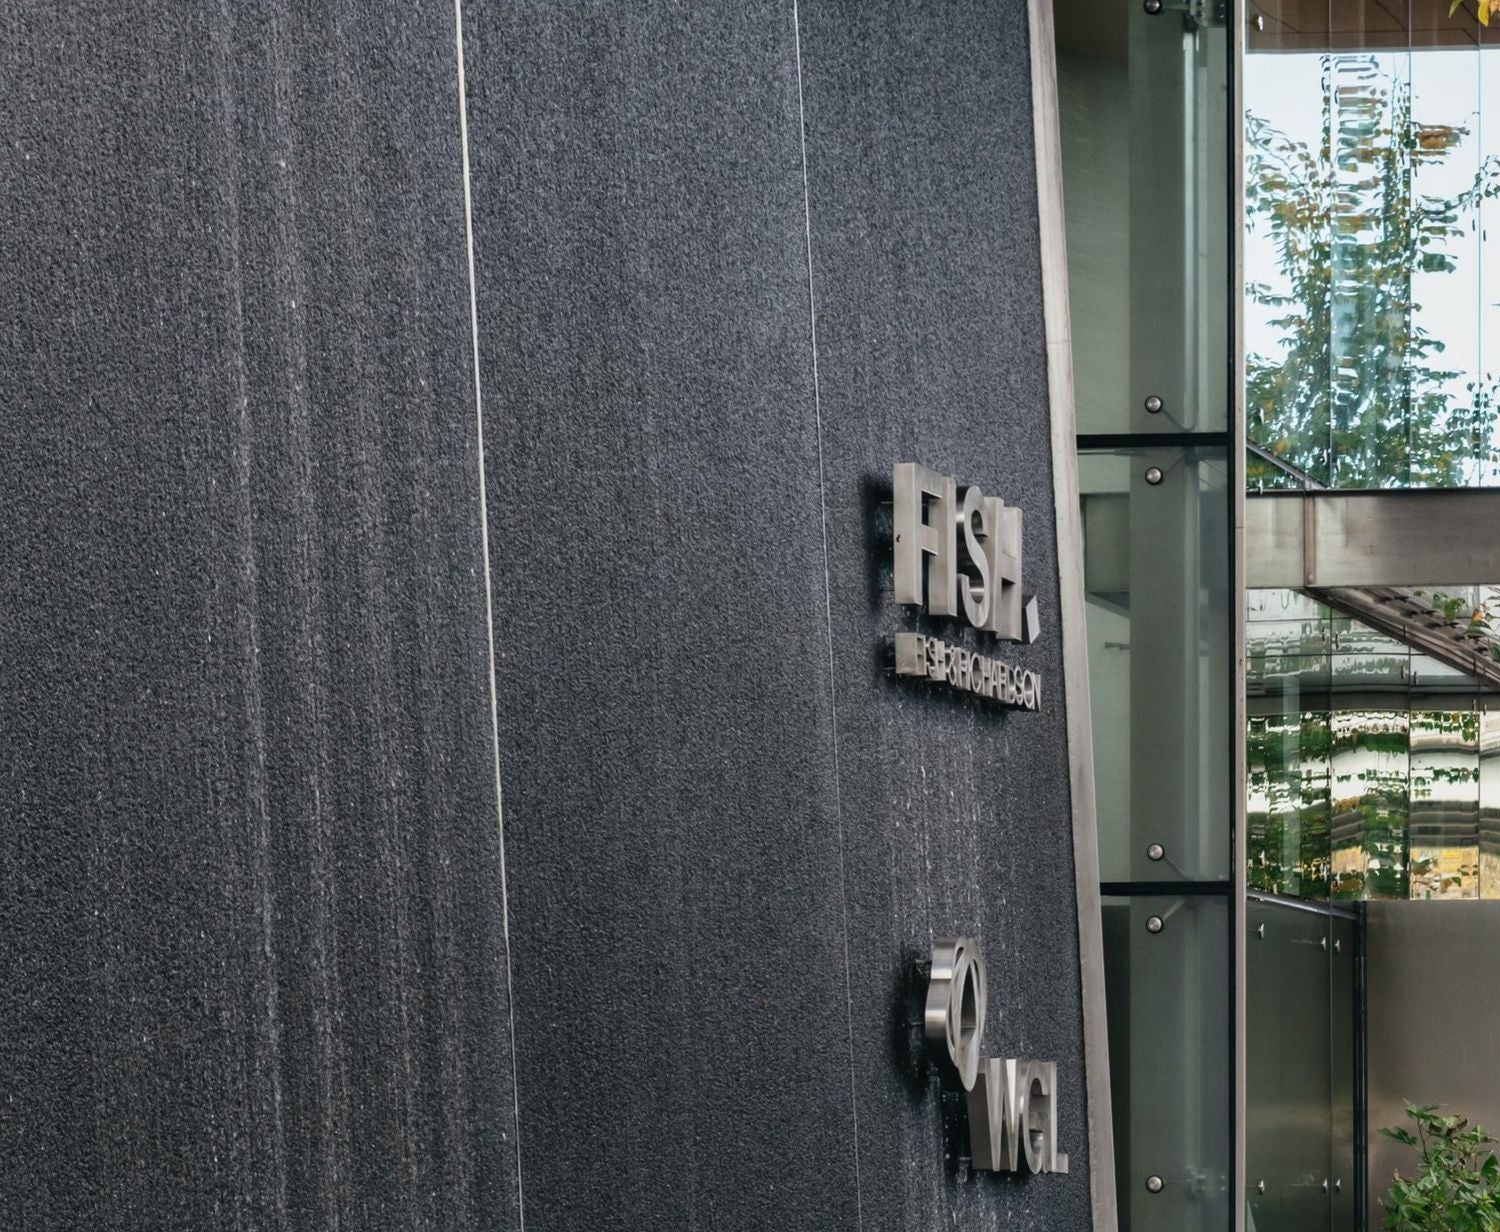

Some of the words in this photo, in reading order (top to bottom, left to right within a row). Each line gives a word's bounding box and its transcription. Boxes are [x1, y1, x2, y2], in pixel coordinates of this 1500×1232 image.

[895, 632, 947, 681] FISH
[946, 644, 958, 687] &
[957, 647, 1041, 712] RICHARDSON
[967, 1056, 1069, 1174] WGL
